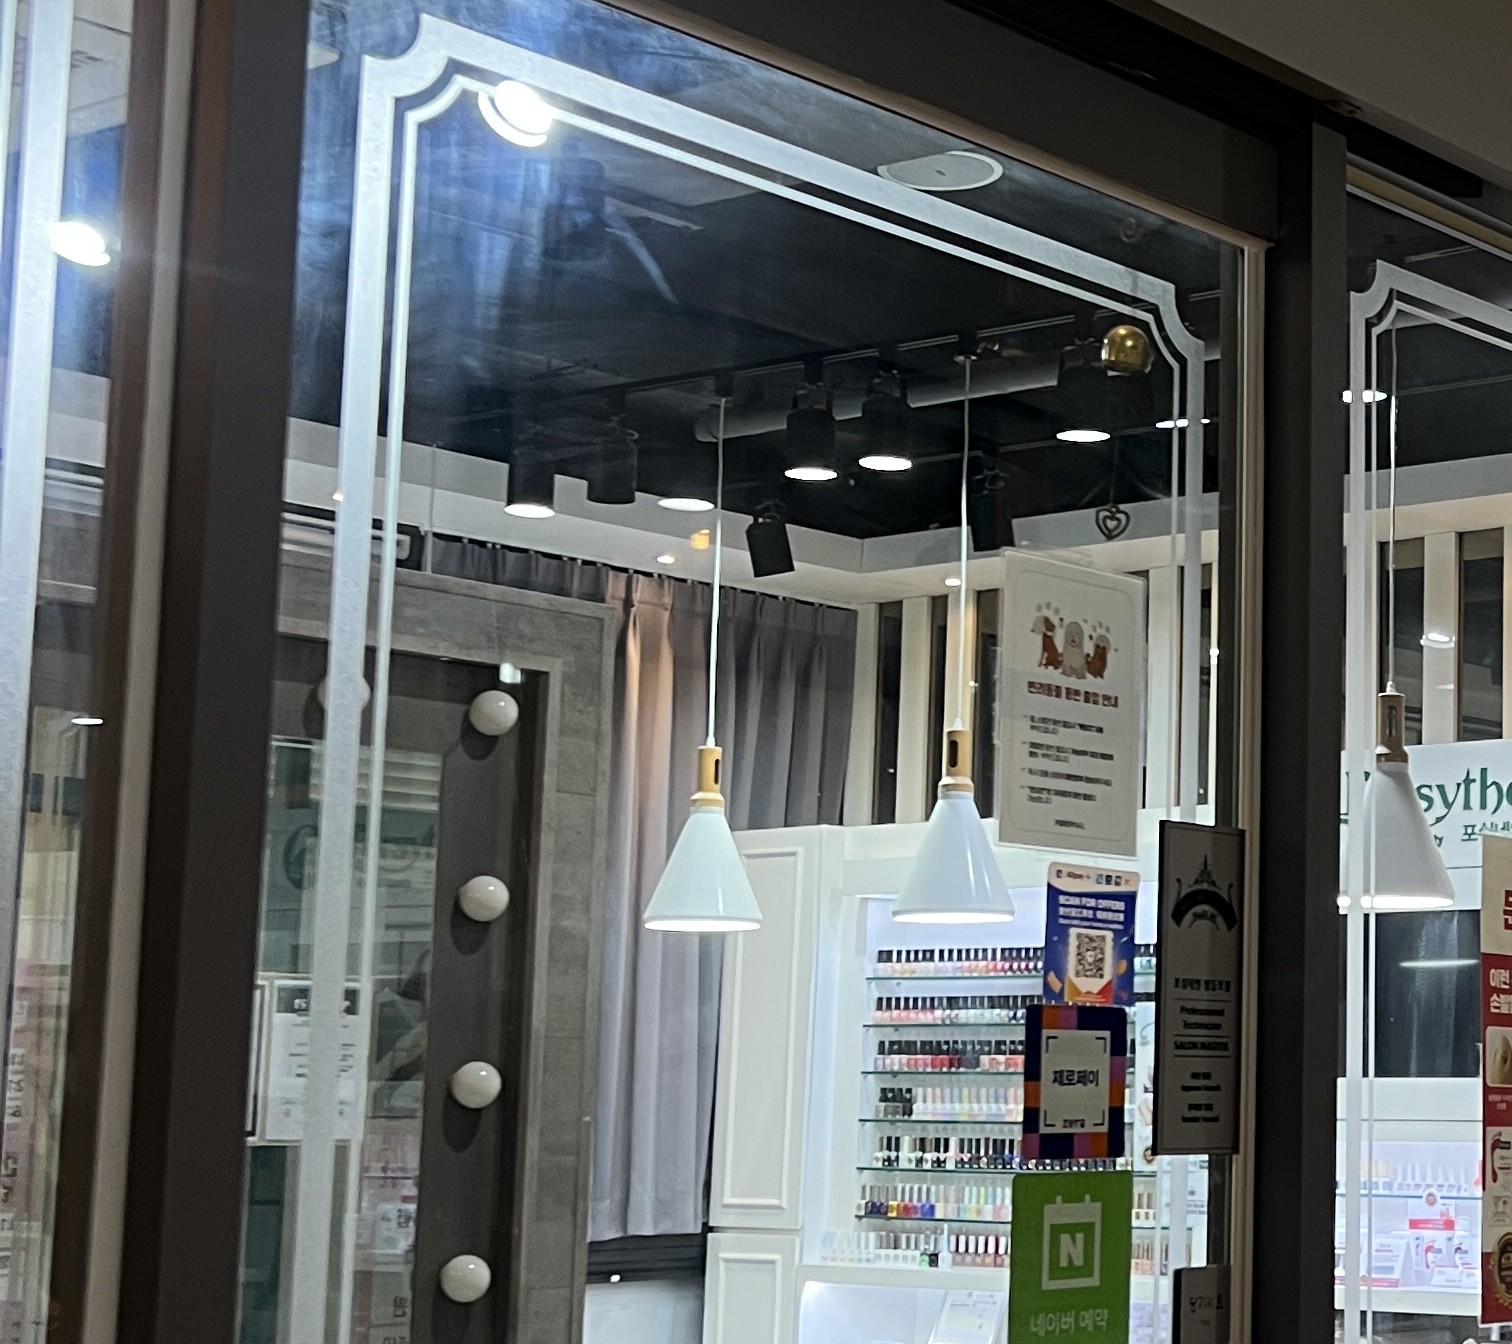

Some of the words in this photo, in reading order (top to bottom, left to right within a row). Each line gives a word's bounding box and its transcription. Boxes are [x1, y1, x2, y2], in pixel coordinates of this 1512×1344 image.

[1052, 1068, 1100, 1089] 제로페이
[1058, 1232, 1085, 1268] N
[1030, 1310, 1075, 1337] 네이버
[1079, 1308, 1109, 1332] 예약
